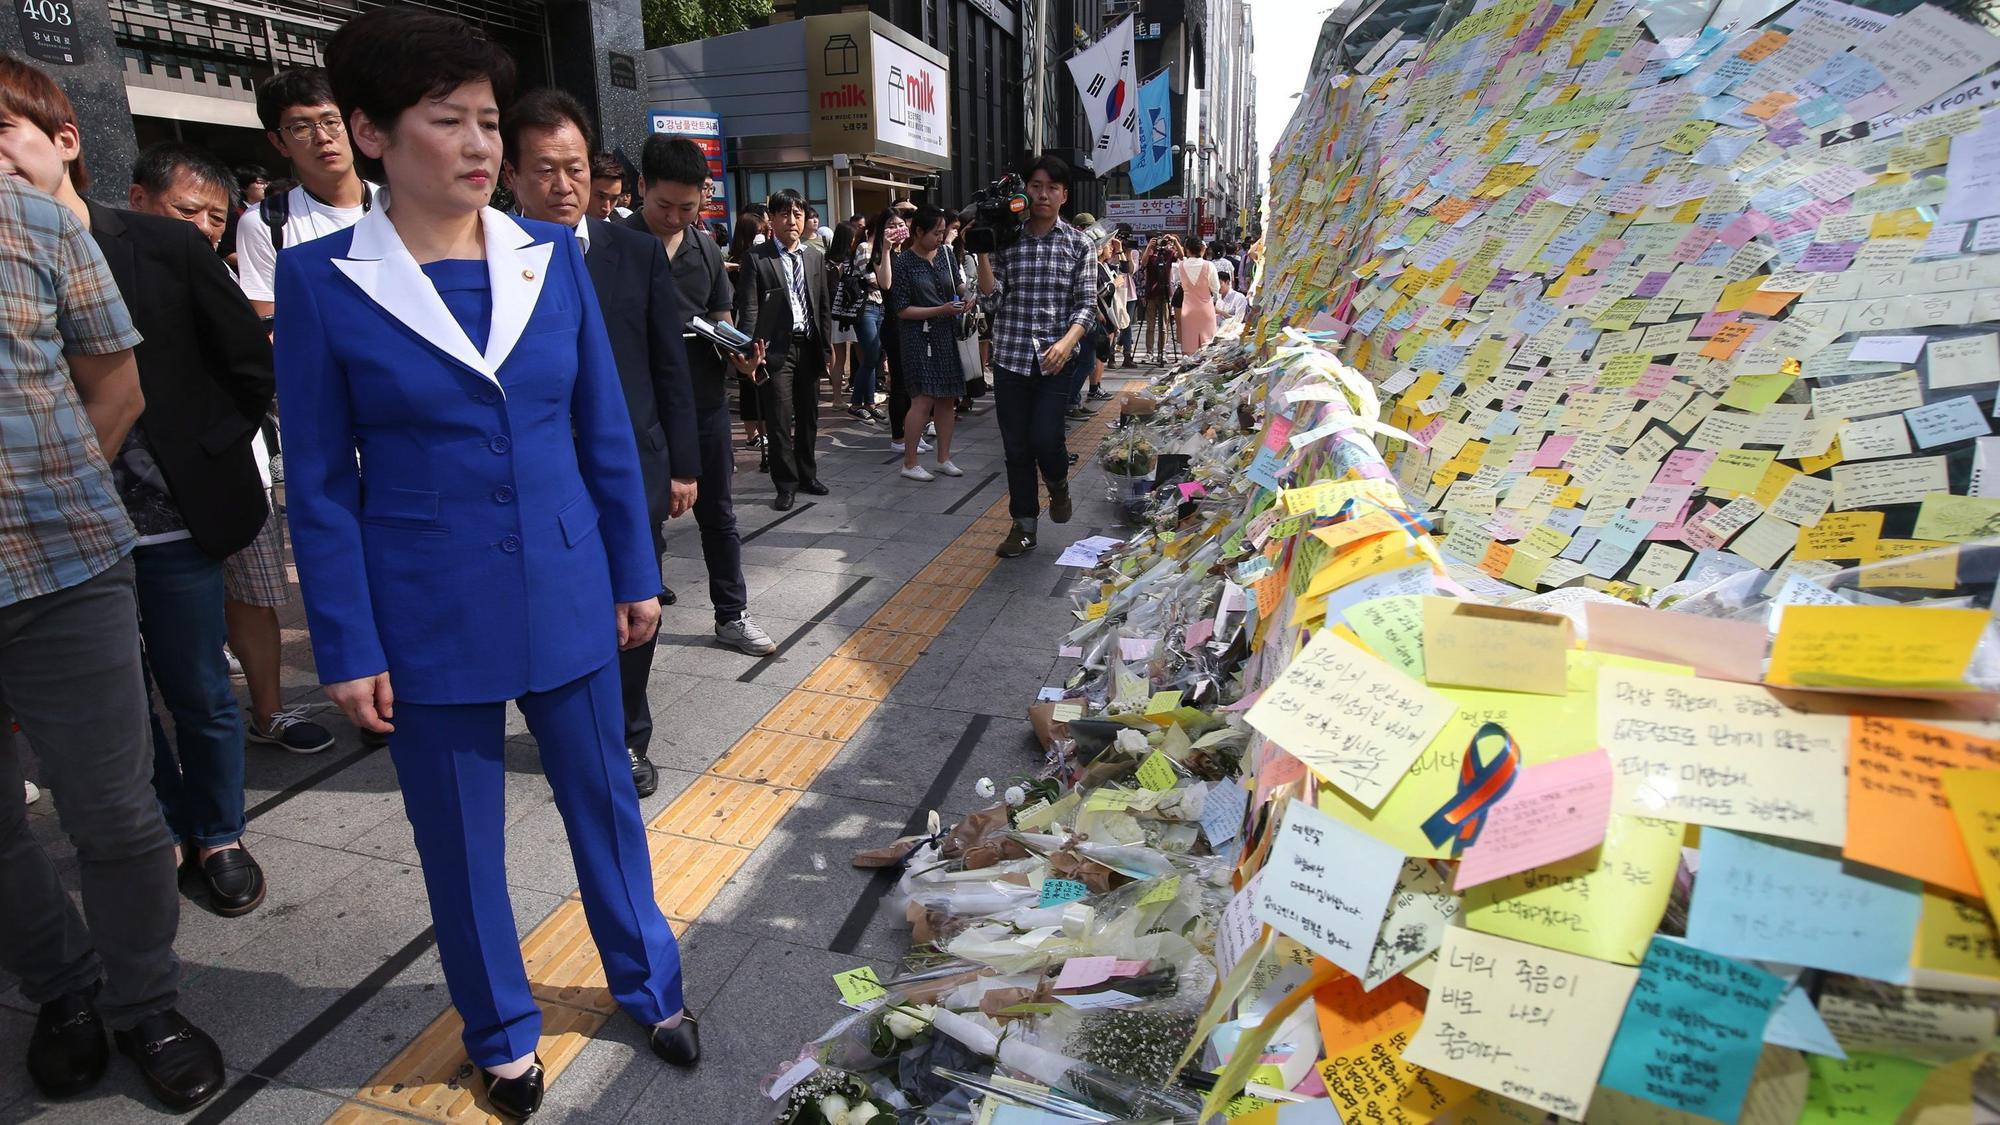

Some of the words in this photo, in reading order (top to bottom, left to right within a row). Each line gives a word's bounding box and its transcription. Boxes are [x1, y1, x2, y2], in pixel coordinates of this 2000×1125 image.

[23, 0, 72, 25] 403
[32, 31, 71, 45] 강남대로
[820, 84, 867, 109] milk
[907, 69, 935, 115] milk
[1940, 86, 1983, 110] FOR
[1449, 946, 1496, 978] 너의
[1515, 959, 1579, 997] 죽음이
[1441, 986, 1482, 1015] 바로
[1508, 1003, 1555, 1027] 나의
